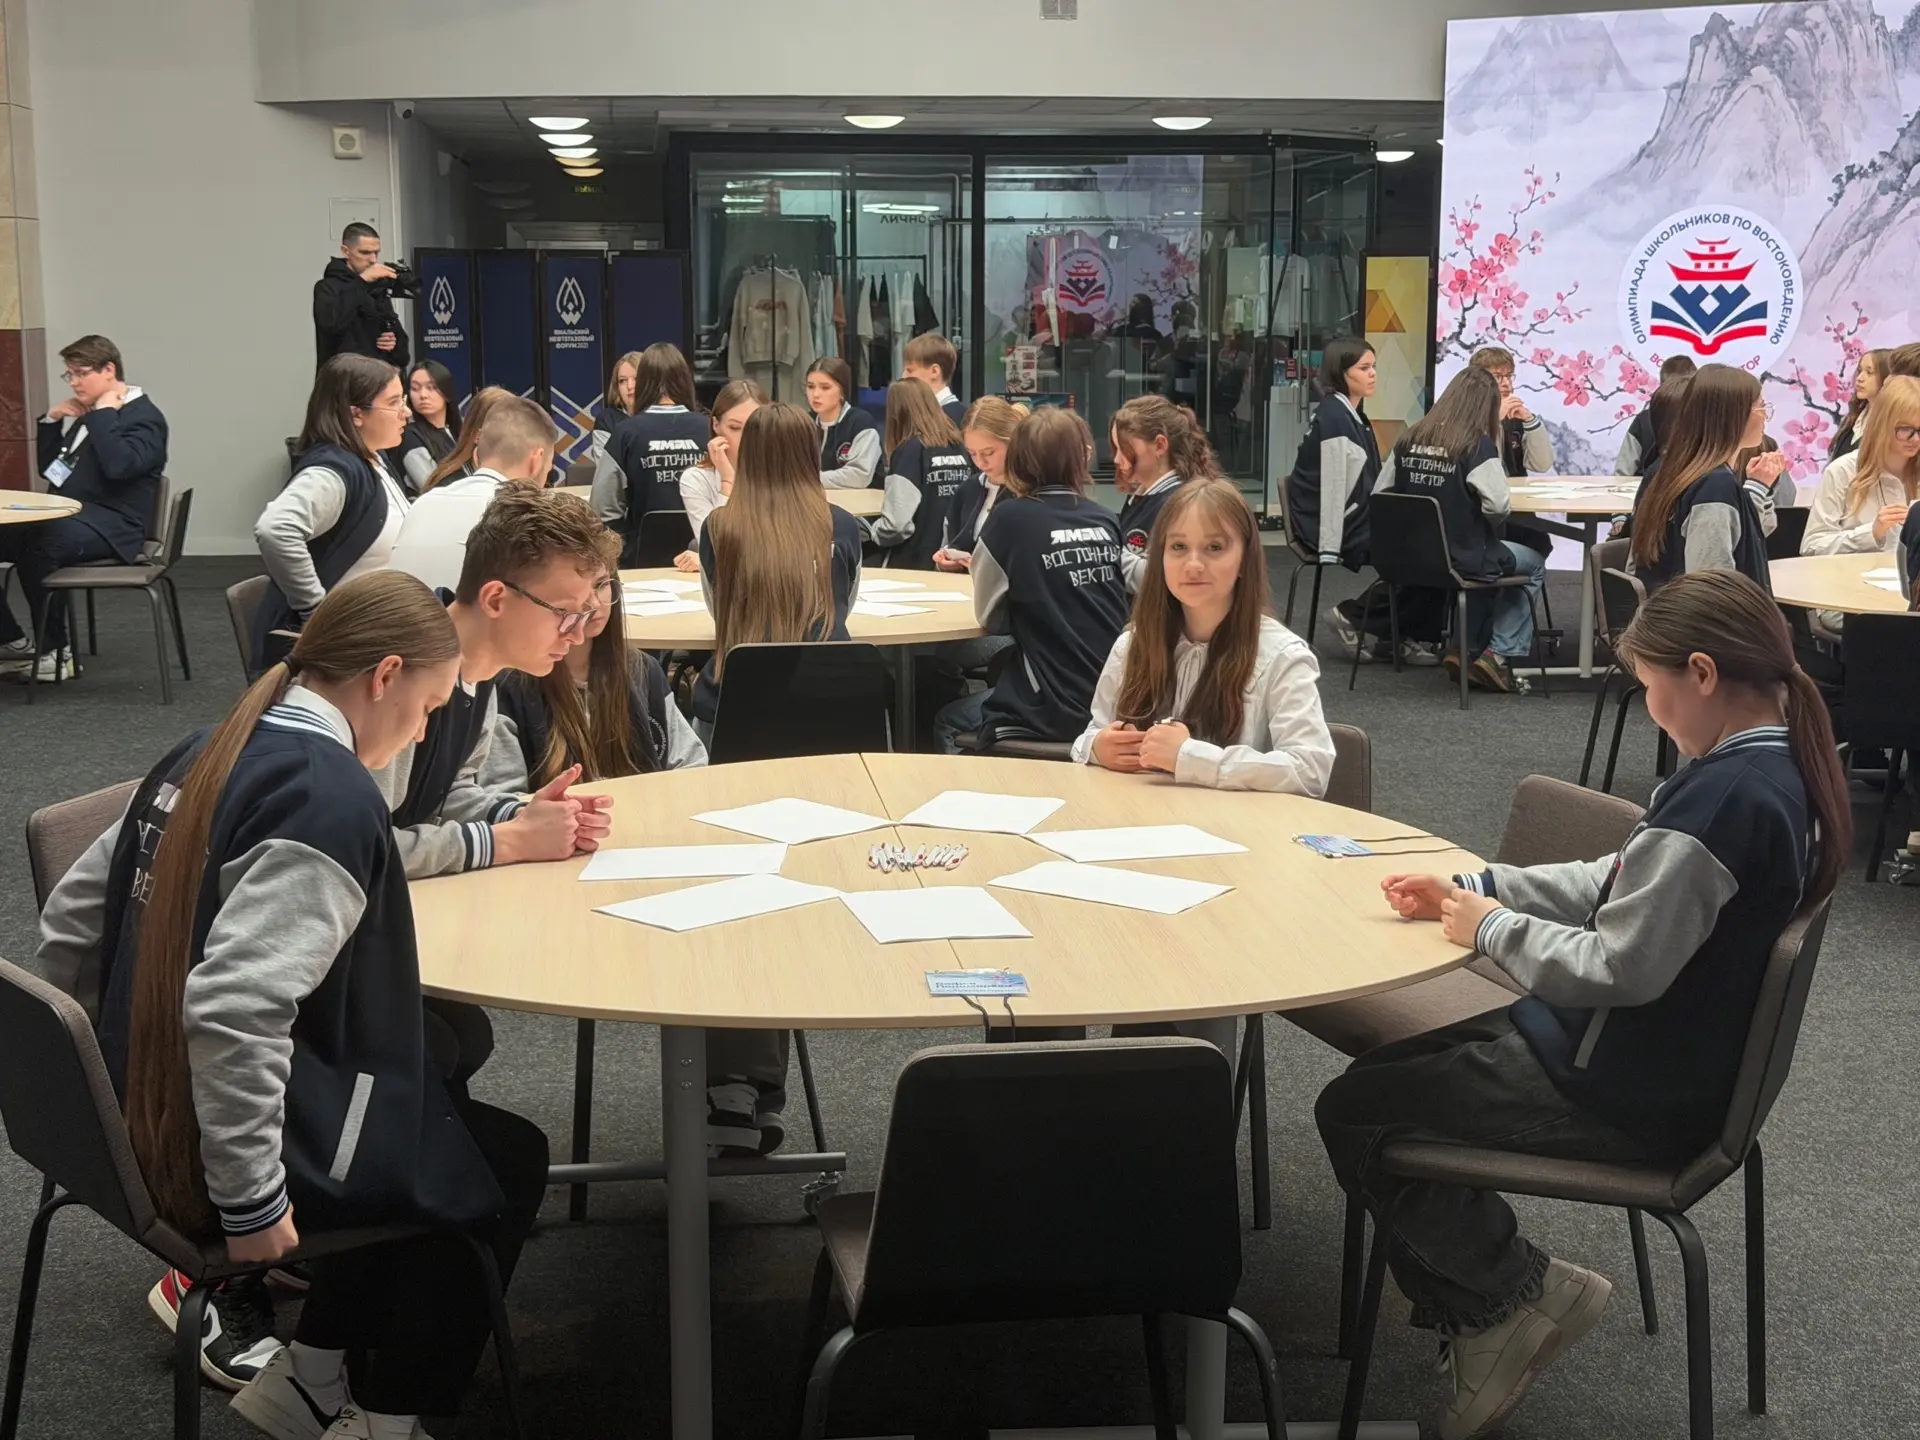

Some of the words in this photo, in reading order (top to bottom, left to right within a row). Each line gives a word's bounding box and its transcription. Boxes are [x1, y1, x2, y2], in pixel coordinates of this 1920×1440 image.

[1628, 258, 1649, 344] ОЛИМПИАДА
[1644, 213, 1731, 257] ШКОЛЬНИКОВ
[1732, 216, 1751, 231] ПО
[1751, 225, 1794, 345] ВОСТОКОВЕДЕНИЮ
[1409, 471, 1446, 487] ВЕКТОР
[1069, 565, 1115, 587] ВЕКТО
